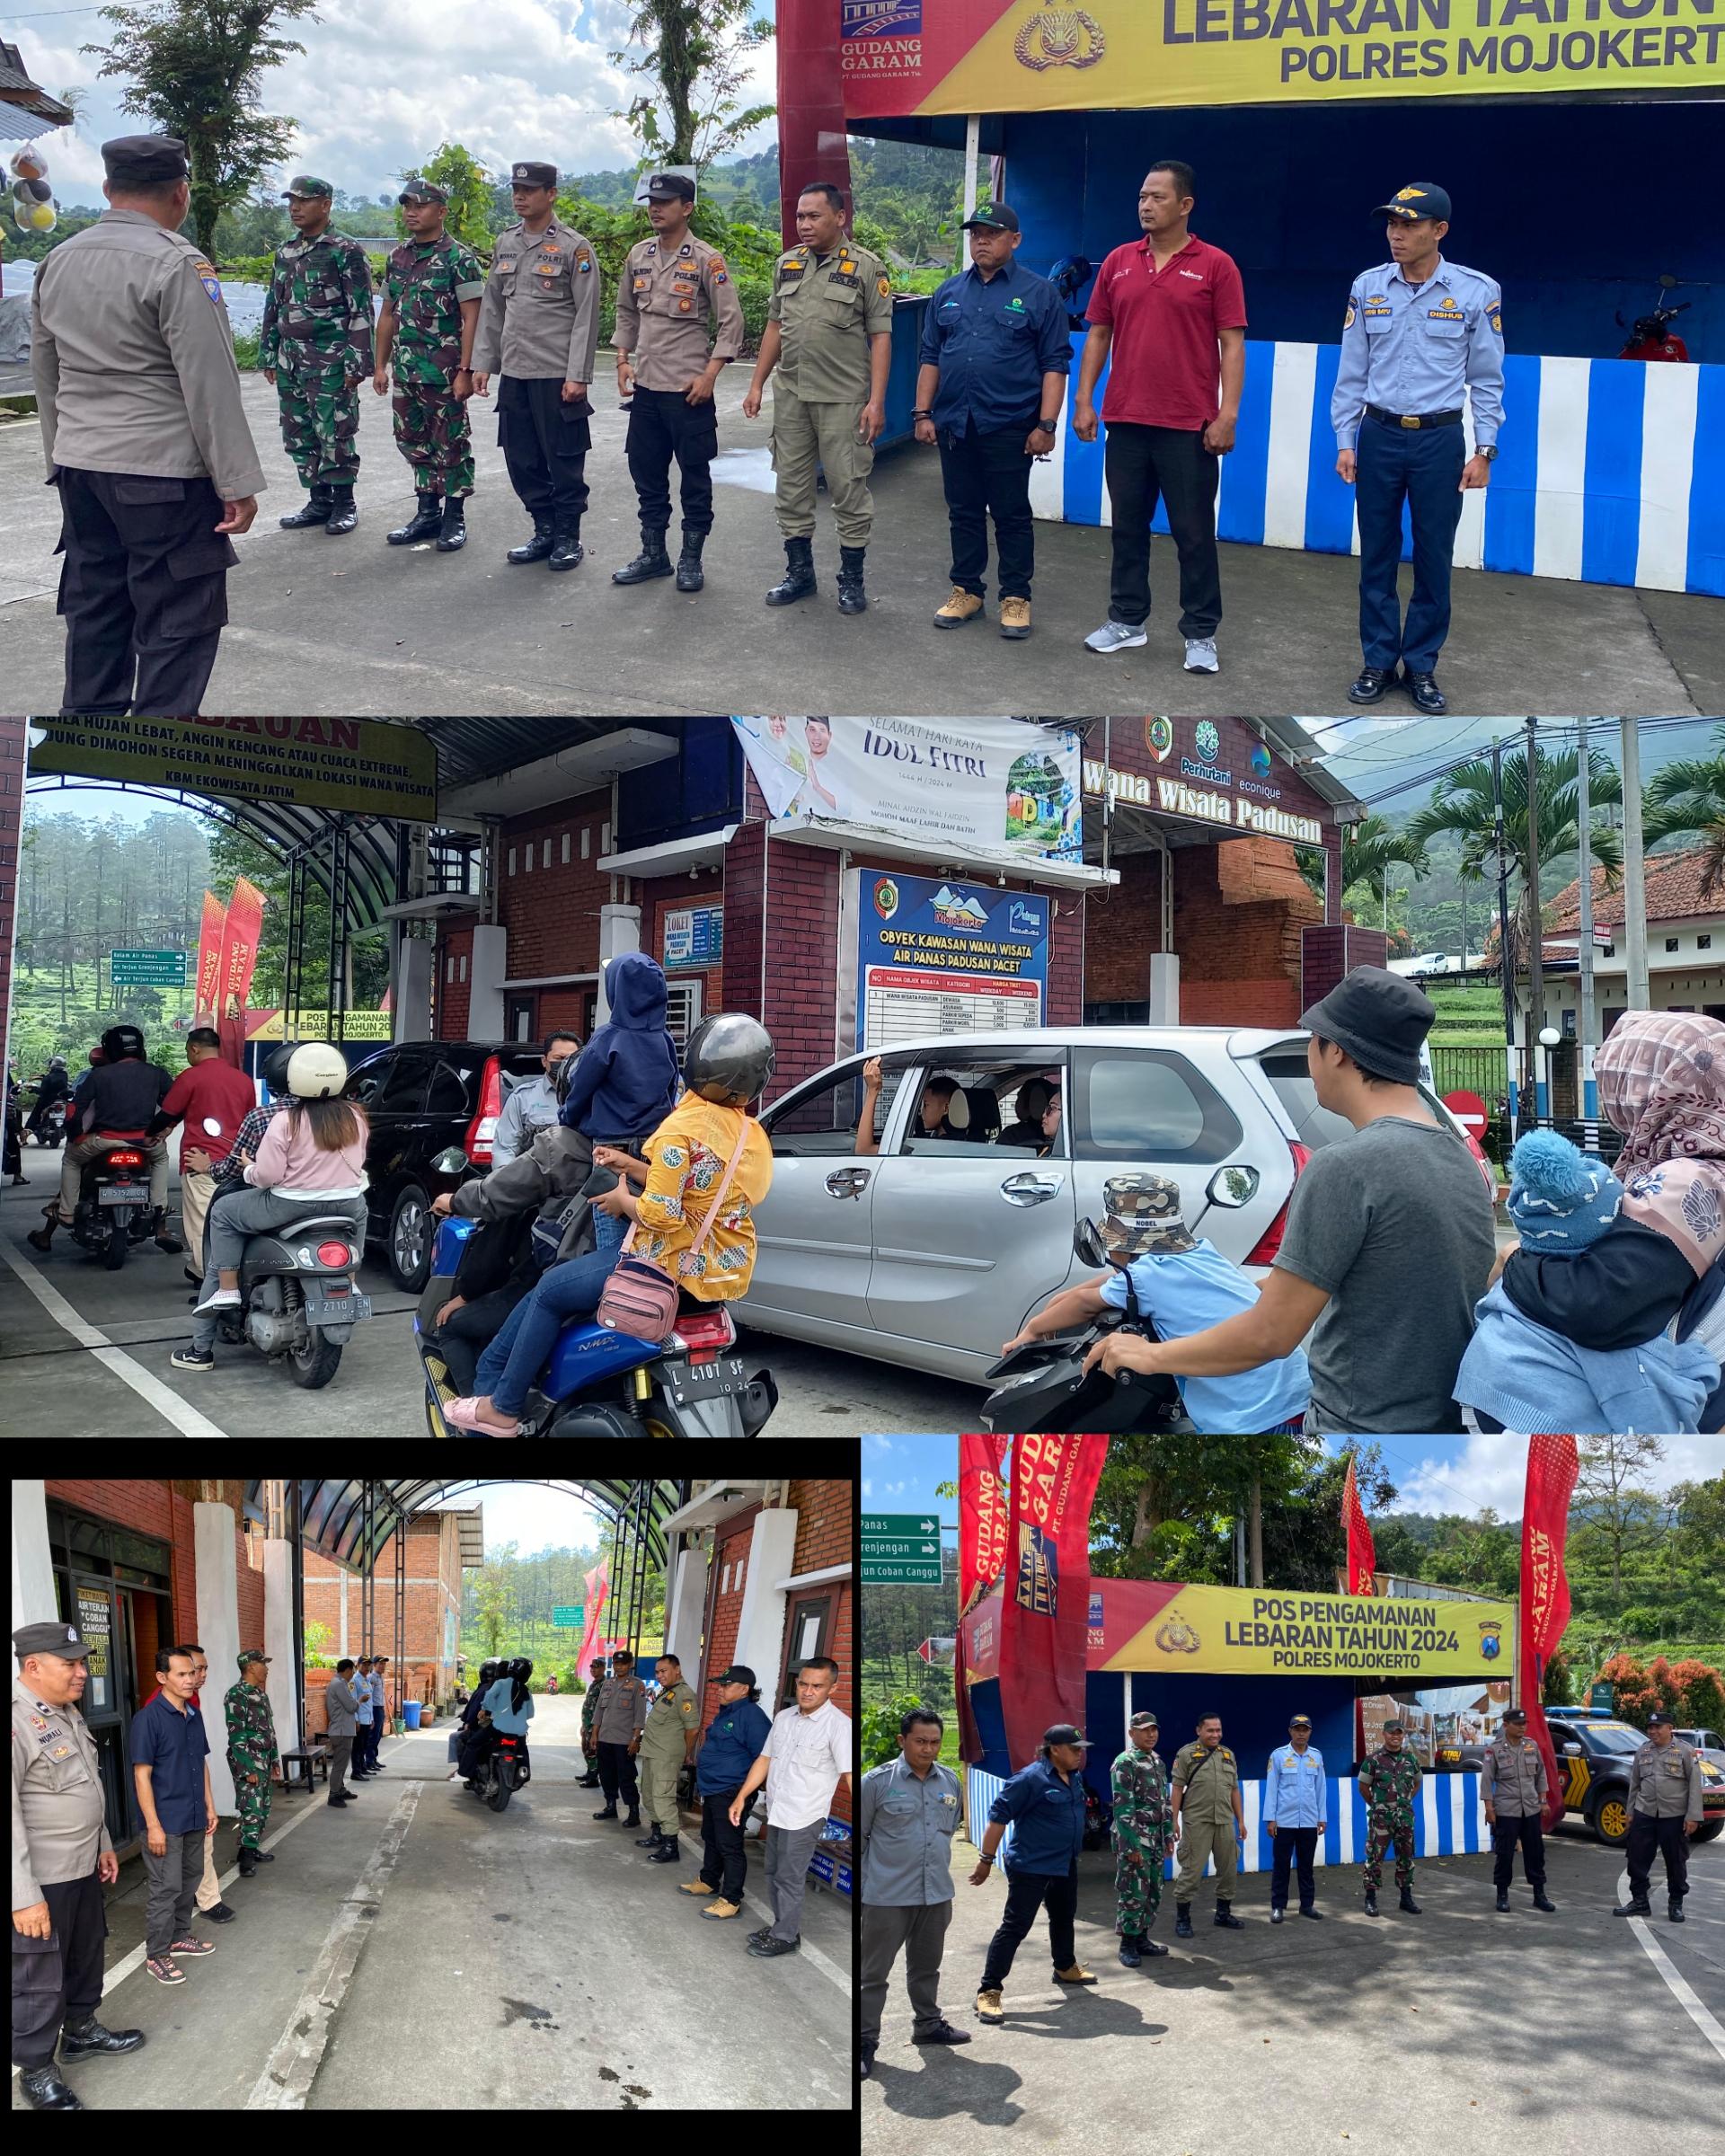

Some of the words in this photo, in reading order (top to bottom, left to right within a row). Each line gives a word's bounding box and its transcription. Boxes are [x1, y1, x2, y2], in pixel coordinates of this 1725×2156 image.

[1163, 0, 1450, 44] LEBARAN
[841, 40, 922, 55] GUDANG
[841, 55, 922, 70] GARAM
[1281, 39, 1448, 83] POLRES
[537, 254, 563, 263] POLRI
[673, 271, 700, 281] POLRI
[830, 273, 845, 283] POL
[846, 277, 858, 286] PP
[1429, 311, 1463, 319] DISHUB
[870, 717, 923, 739] SELAMAT
[925, 729, 953, 745] HARI
[955, 736, 983, 752] RAYA
[84, 718, 130, 735] HUJAN
[134, 723, 180, 743] LEBAT,
[181, 730, 226, 749] ANGIN
[228, 738, 285, 758] KENCANG
[288, 748, 317, 763] ATAU
[321, 754, 358, 770] CUACA
[360, 759, 412, 779] EXTREME,
[863, 729, 923, 764] IDUL
[929, 746, 986, 778] FITRI
[90, 735, 157, 756] DIMOHON
[161, 747, 211, 764] SEGERA
[214, 755, 314, 781] MENINGGALKAN
[316, 769, 357, 786] LOKASI
[359, 775, 392, 791] WANA
[395, 782, 434, 798] WISATA
[1181, 756, 1231, 786] Perhutani
[165, 770, 193, 784] KBM
[196, 774, 261, 794] EKOWISATA
[262, 783, 295, 799] JATIM
[928, 778, 944, 787] 2024
[1239, 779, 1281, 800] econique
[1083, 757, 1151, 806] Wana
[1156, 777, 1232, 824] Wisata
[1236, 798, 1322, 844] Padusan
[878, 800, 900, 810] MINAL
[903, 804, 927, 816] AIDZIN
[928, 808, 942, 818] WAL
[943, 811, 970, 823] FAIDZIN
[871, 810, 898, 821] MOHON
[898, 815, 918, 826] MAAF
[919, 818, 939, 828] LAHIR
[941, 821, 955, 831] DAN
[956, 824, 976, 835] BATIN
[668, 916, 689, 931] LOKET
[934, 911, 983, 929] Mojokerto
[879, 930, 917, 946] OBYEK
[918, 934, 968, 952] KAWASAN
[969, 939, 997, 955] WANA
[999, 943, 1032, 959] WISATA
[228, 941, 239, 989] GUDANG
[893, 949, 911, 963] AIR
[913, 951, 946, 966] PANAS
[948, 955, 991, 970] PADUSAN
[993, 959, 1021, 974] PACET
[306, 1013, 325, 1021] POS
[327, 1012, 391, 1022] GAMANAN
[343, 1023, 377, 1031] TAHUN
[308, 1303, 314, 1312] W
[323, 1301, 347, 1312] 2710
[358, 1298, 368, 1308] EN
[673, 1371, 682, 1386] L
[691, 1363, 721, 1382] 4107
[730, 1358, 743, 1375] SF
[720, 1383, 731, 1393] 10
[738, 1381, 749, 1391] 24
[1019, 1434, 1046, 1511] GUD
[1056, 1462, 1075, 1515] GUDANG
[976, 1470, 995, 1575] GUDANG
[1052, 1518, 1062, 1533] PT.
[877, 1567, 903, 1576] Coban
[906, 1567, 938, 1578] Canggu
[78, 1601, 89, 1611] AIR
[89, 1602, 109, 1613] TERJUN
[1253, 1598, 1296, 1621] POS
[1300, 1601, 1436, 1627] PENGAMANAN
[83, 1634, 109, 1644] DEWASA
[1225, 1621, 1335, 1649] LEBARAN
[1336, 1626, 1408, 1651] TAHUN
[1411, 1630, 1459, 1652] 2024
[89, 1656, 106, 1665] ANAK
[1273, 1651, 1332, 1668] POLRES
[1335, 1652, 1420, 1669] MOJOKERTO
[39, 1728, 63, 1745] NURALI
